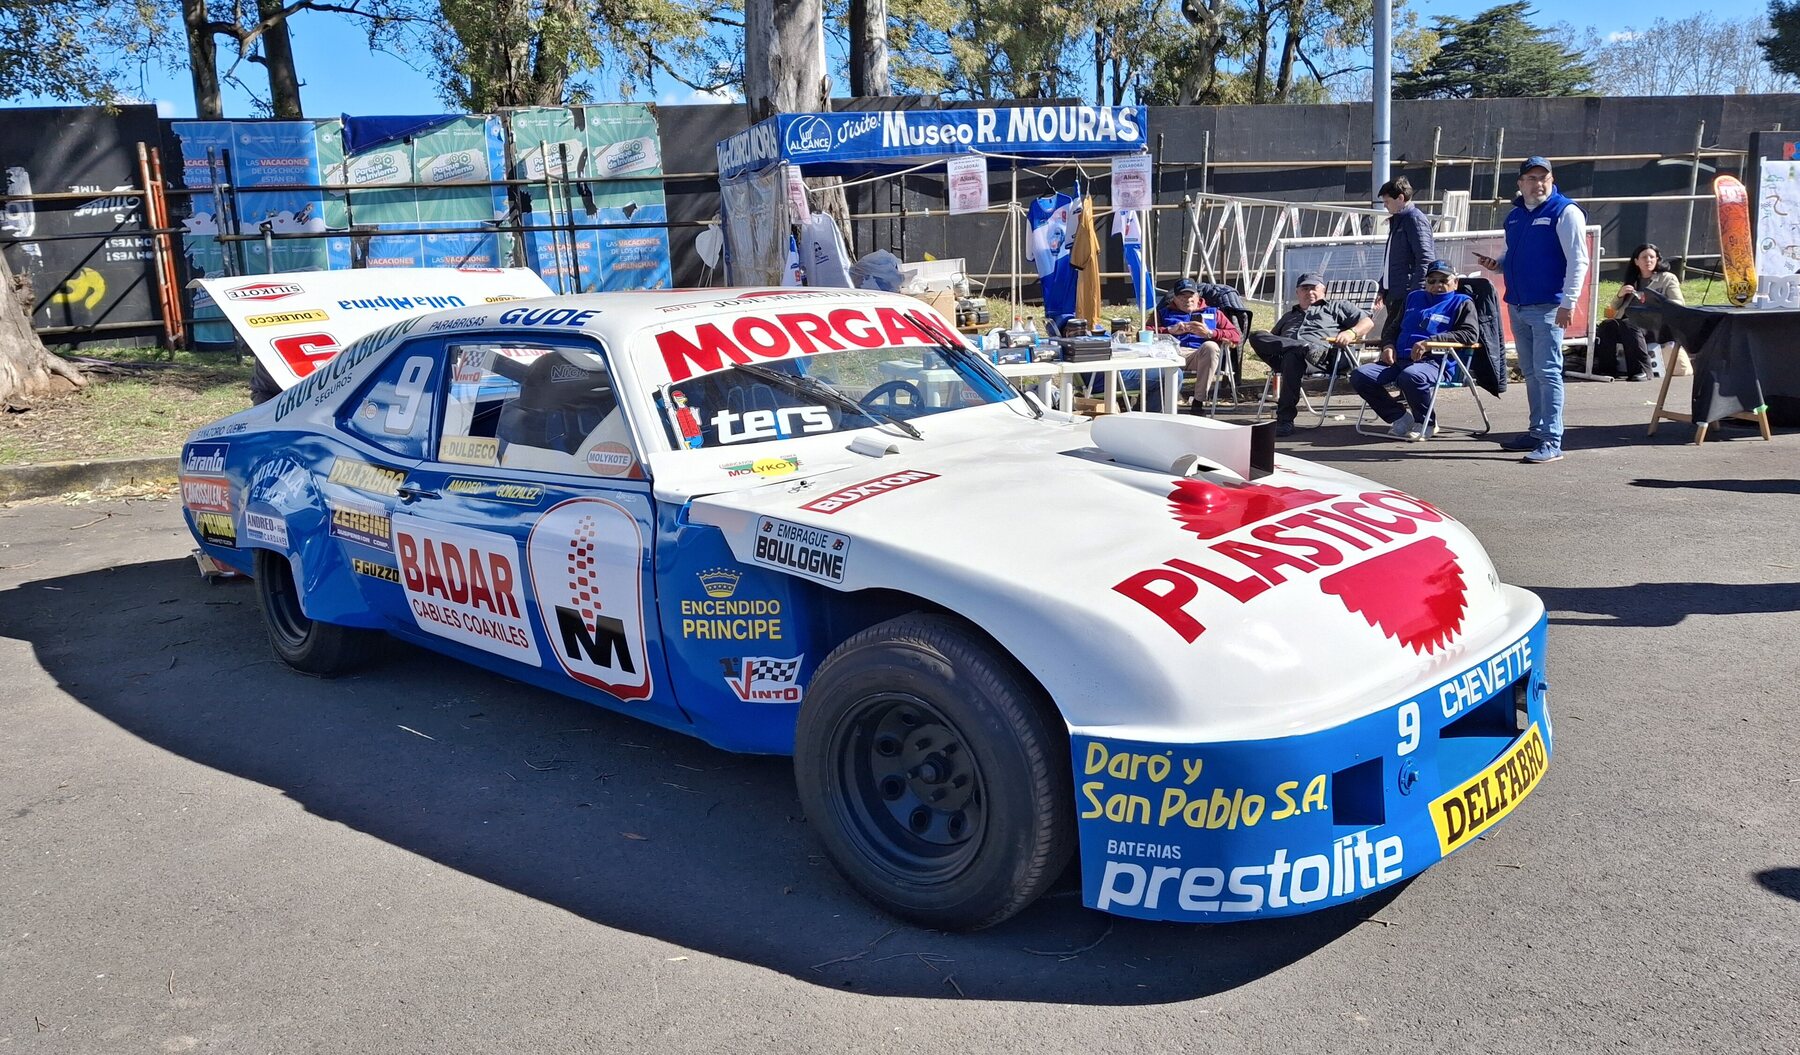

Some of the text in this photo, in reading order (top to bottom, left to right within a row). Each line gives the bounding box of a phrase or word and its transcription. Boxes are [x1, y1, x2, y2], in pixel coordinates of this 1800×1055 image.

[882, 110, 973, 148] Museo
[977, 110, 1001, 143] R.
[1007, 106, 1139, 143] MOURAS
[607, 150, 633, 163] Parque
[791, 138, 829, 150] ALCANCE
[261, 158, 309, 166] VACACIONES
[355, 163, 383, 177] Parque
[432, 163, 460, 175] Parque
[432, 173, 444, 183] de
[443, 165, 475, 180] Invierno
[355, 174, 367, 184] de
[366, 166, 399, 182] Invierno
[618, 238, 660, 247] VACACIONES
[368, 257, 415, 265] VACACIONES
[228, 284, 300, 299] SILIKOTE
[337, 294, 415, 312] Alpina
[416, 294, 466, 310] Villa
[249, 311, 313, 325] DULBECCO
[427, 315, 488, 332] PARABRISAS
[499, 307, 602, 327] GUDE
[274, 315, 424, 423] GRUPO CABILDO
[453, 351, 482, 382] VINTO
[314, 372, 353, 407] SEGUROS
[383, 355, 434, 435] 9
[710, 405, 833, 444] ters
[186, 447, 225, 472] taranto
[588, 449, 629, 465] MOLYKOTE
[727, 459, 805, 478] MOLYKOTE
[330, 459, 405, 494] DELFABRO
[811, 470, 925, 512] BUXTON
[247, 514, 274, 532] ANDREO
[332, 503, 391, 540] ZERBINI
[336, 528, 391, 549] SUSPENSION COMP.
[777, 523, 829, 549] EMBRAGUE
[755, 535, 844, 580] BOULOGNE
[1111, 488, 1455, 645] PLASTICO
[397, 532, 521, 618] BADAR
[681, 599, 781, 616] ENCENDIDO
[412, 597, 530, 649] CABLES COAXILES
[682, 619, 782, 640] PRINCIPE
[555, 604, 636, 675] M
[731, 660, 799, 701] VINTO
[1438, 635, 1533, 719] CHEVETTE
[1397, 701, 1421, 757] 9
[1084, 742, 1204, 785] Daró y
[1444, 730, 1545, 845] DELFABRO
[1080, 773, 1329, 831] San Pablo S.A.
[1107, 838, 1183, 860] BATERIAS
[1096, 829, 1405, 913] prestolite
